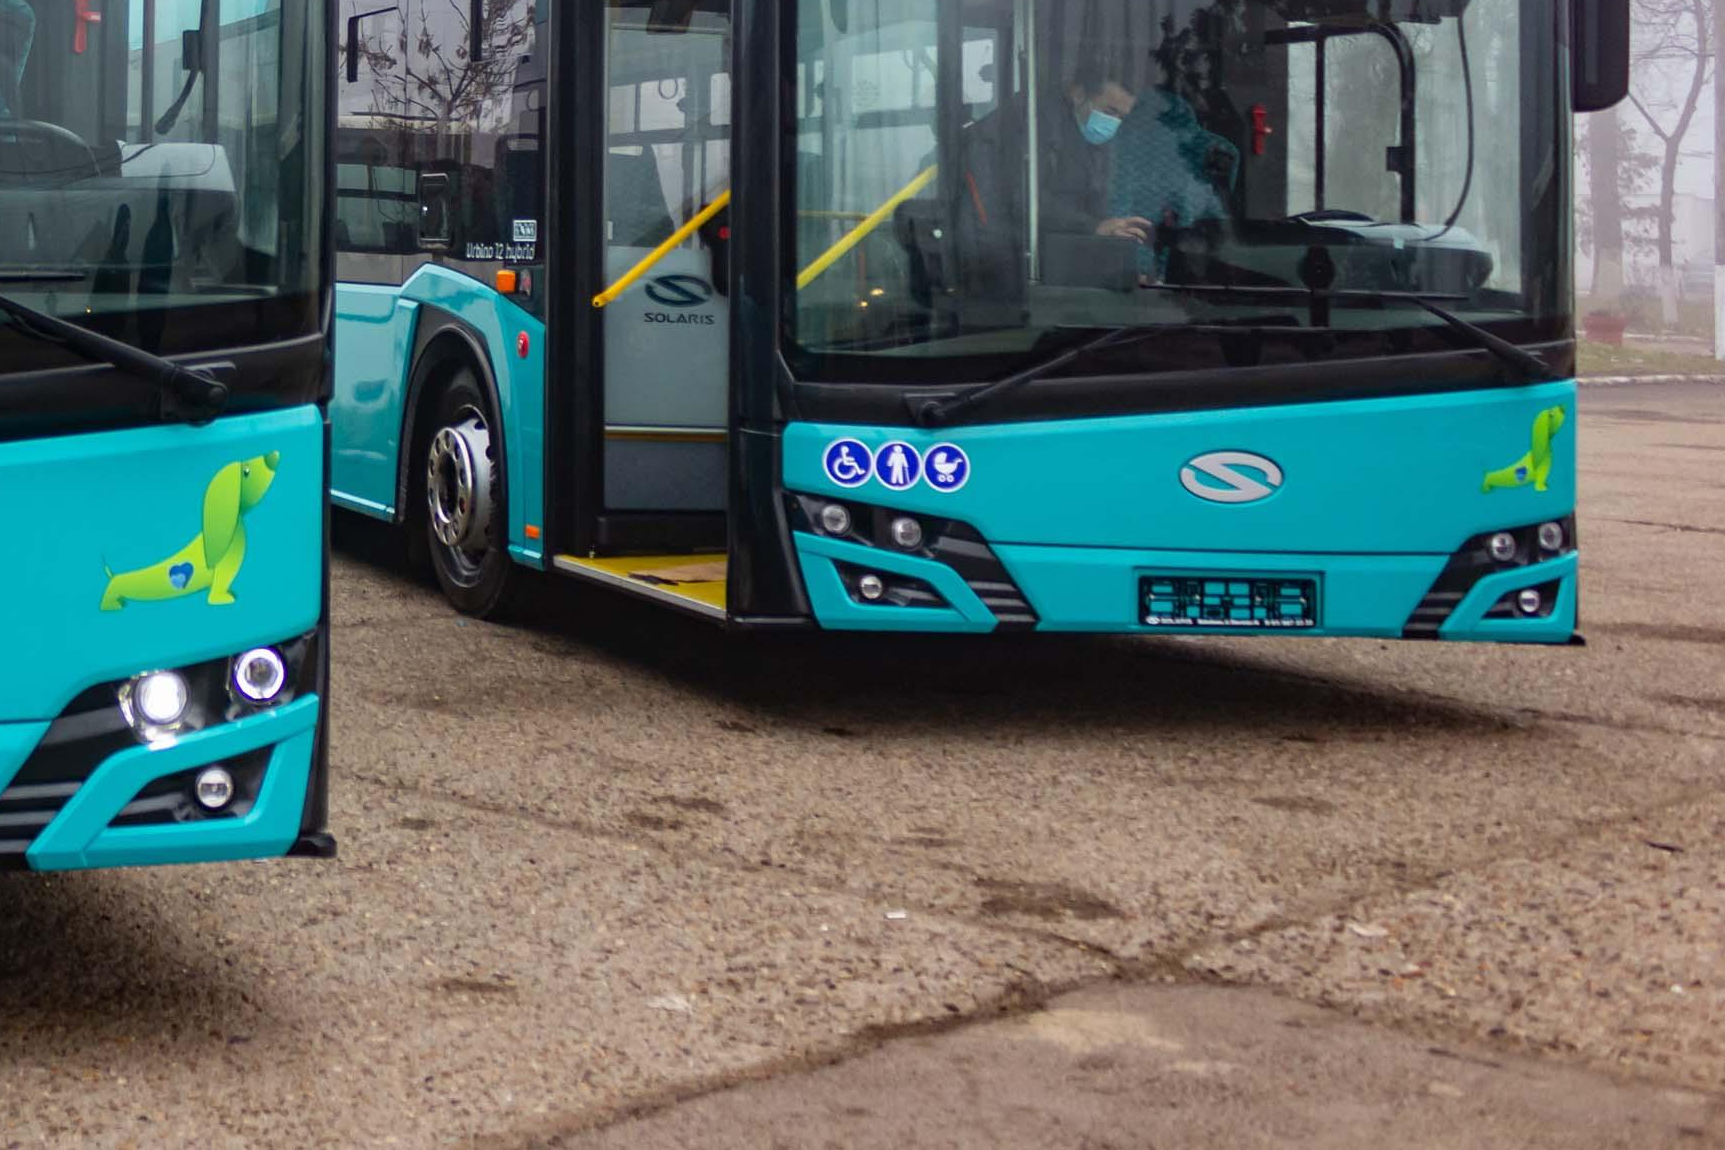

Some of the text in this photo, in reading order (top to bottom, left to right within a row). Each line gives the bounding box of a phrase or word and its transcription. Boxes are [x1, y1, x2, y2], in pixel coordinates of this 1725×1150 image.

[466, 242, 535, 263] Urbino 12 hybrid
[644, 312, 715, 325] SOLARIS
